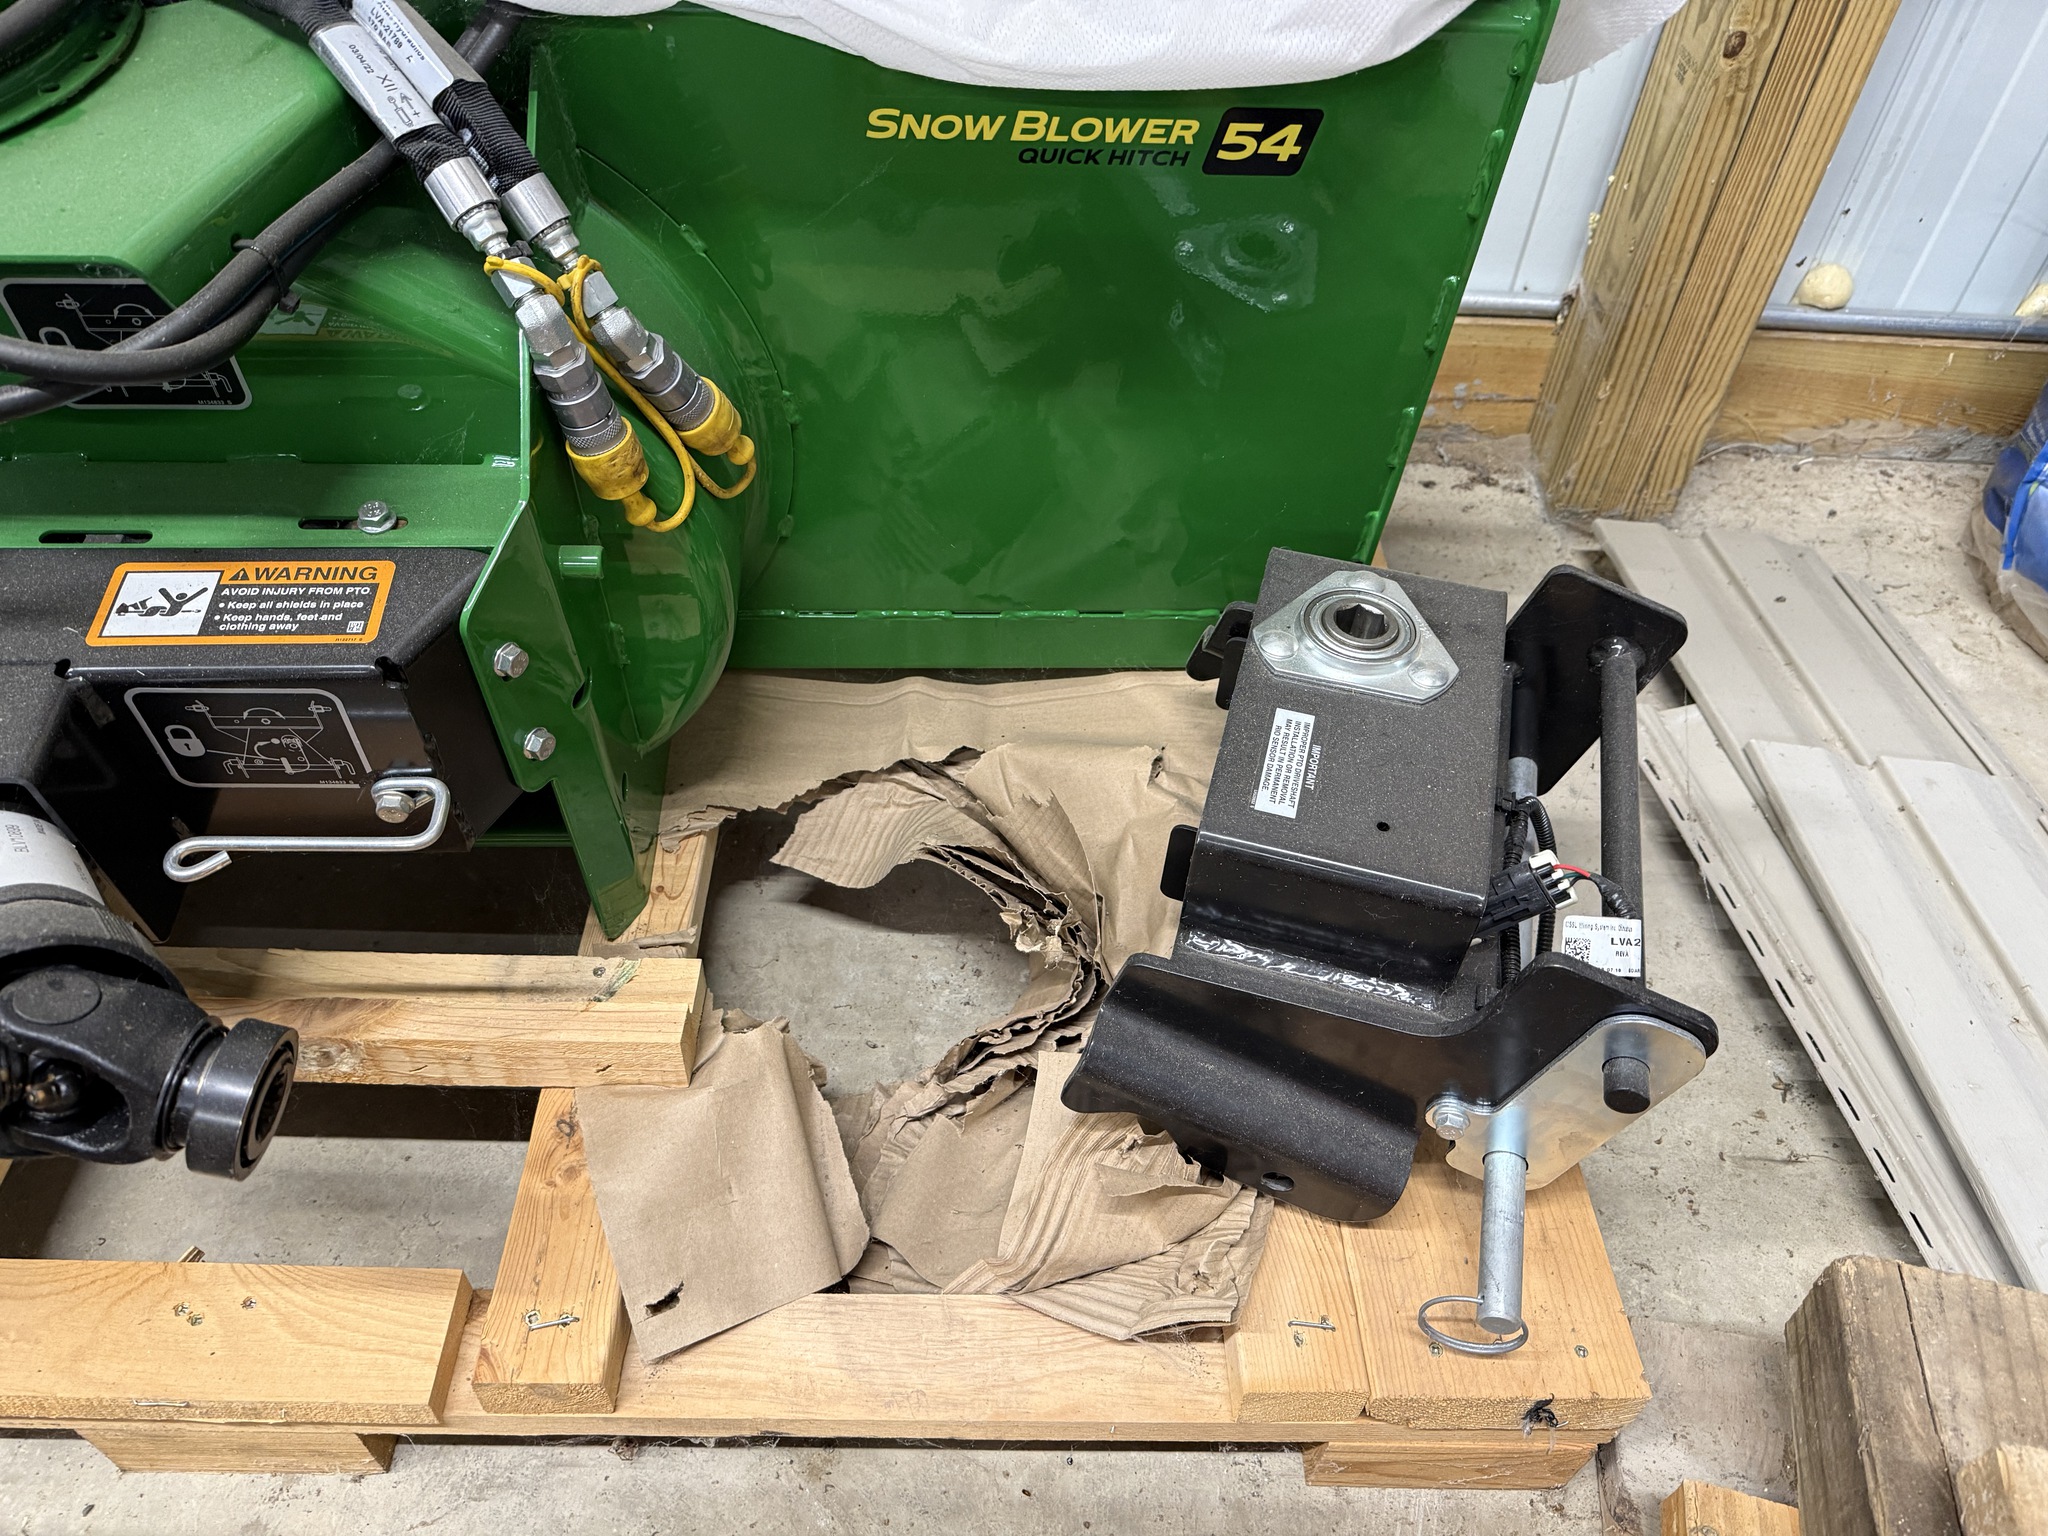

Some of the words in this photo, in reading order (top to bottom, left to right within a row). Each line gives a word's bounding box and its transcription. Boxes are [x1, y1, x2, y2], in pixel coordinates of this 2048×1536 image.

[866, 108, 1006, 140] SNOW
[1010, 110, 1200, 144] BLOWER
[1216, 122, 1302, 162] 54
[1018, 148, 1106, 166] QUICK
[1107, 150, 1190, 167] HITCH
[254, 566, 378, 580] WARNING
[223, 614, 252, 623] Keep
[255, 613, 293, 621] hands,
[227, 601, 256, 610] Keep
[276, 600, 317, 609] shields
[332, 600, 364, 610] place
[219, 623, 266, 632] clothing
[1284, 719, 1292, 731] MAY
[1299, 722, 1310, 753] IMPROPER
[1268, 736, 1279, 763] SENSOR
[1279, 732, 1290, 757] RESULT
[1287, 721, 1302, 763] INSTALLATION
[1285, 763, 1293, 773] OR
[1296, 754, 1305, 767] PTO
[1305, 744, 1322, 790] IMPORTANT
[1261, 762, 1274, 791] DAMAGE.
[1269, 764, 1283, 804] PERMANENT
[1278, 773, 1291, 805] REMOVAL
[1288, 767, 1302, 808] DRIVESHAFT
[1611, 937, 1641, 946] LVA2
